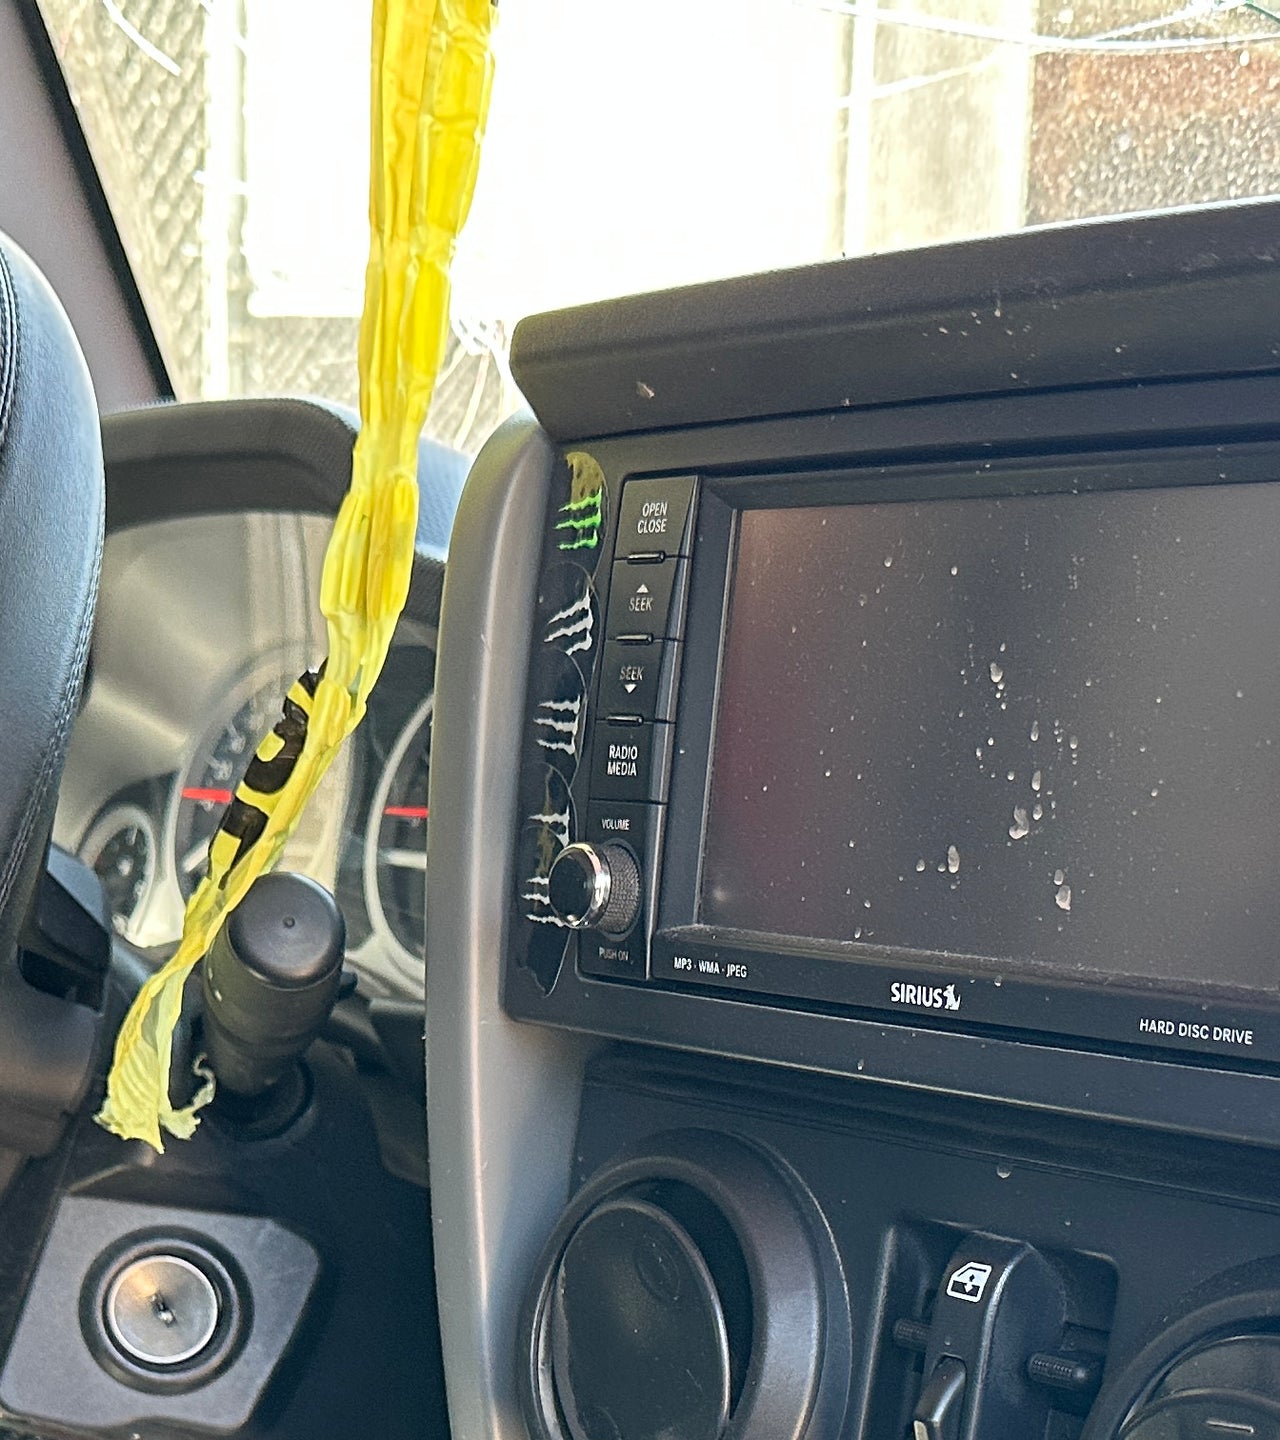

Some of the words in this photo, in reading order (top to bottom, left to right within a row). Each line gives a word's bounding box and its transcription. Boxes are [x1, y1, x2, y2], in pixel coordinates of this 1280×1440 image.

[642, 501, 668, 517] OPEN
[637, 518, 668, 534] CLOSE
[628, 596, 653, 612] SEEK
[619, 665, 645, 681] SEEK
[608, 743, 638, 760] RADIO
[607, 760, 638, 776] MEDIA
[601, 818, 631, 831] VOLUME
[673, 956, 692, 971] MP3
[699, 959, 720, 975] WMA
[725, 963, 748, 979] JPEG
[889, 982, 943, 1009] SIRIUS
[1139, 1017, 1175, 1036] HARD
[1178, 1023, 1210, 1041] DISC
[1212, 1027, 1254, 1046] DRIVE
